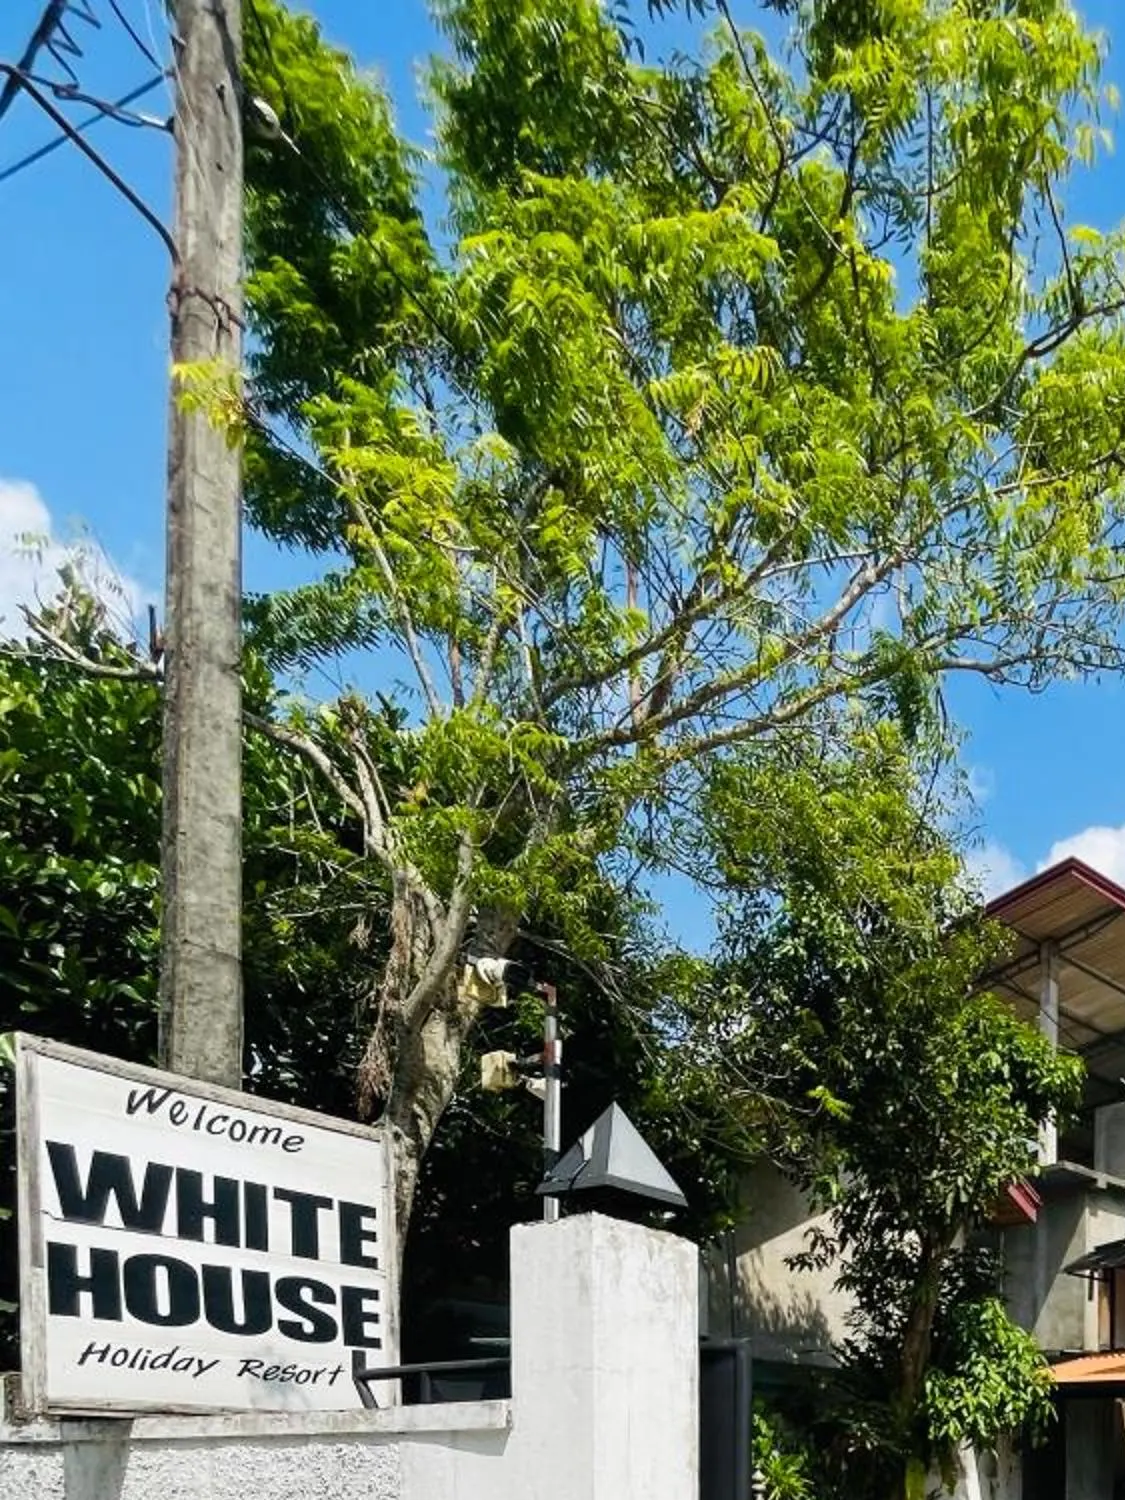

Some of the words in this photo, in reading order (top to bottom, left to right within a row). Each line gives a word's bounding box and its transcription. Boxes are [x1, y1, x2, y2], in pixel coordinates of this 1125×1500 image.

[126, 1086, 305, 1153] Welcome
[45, 1140, 379, 1269] WHITE
[46, 1241, 382, 1349] HOUSE
[77, 1341, 219, 1377] Holiday
[236, 1358, 345, 1386] Resort
